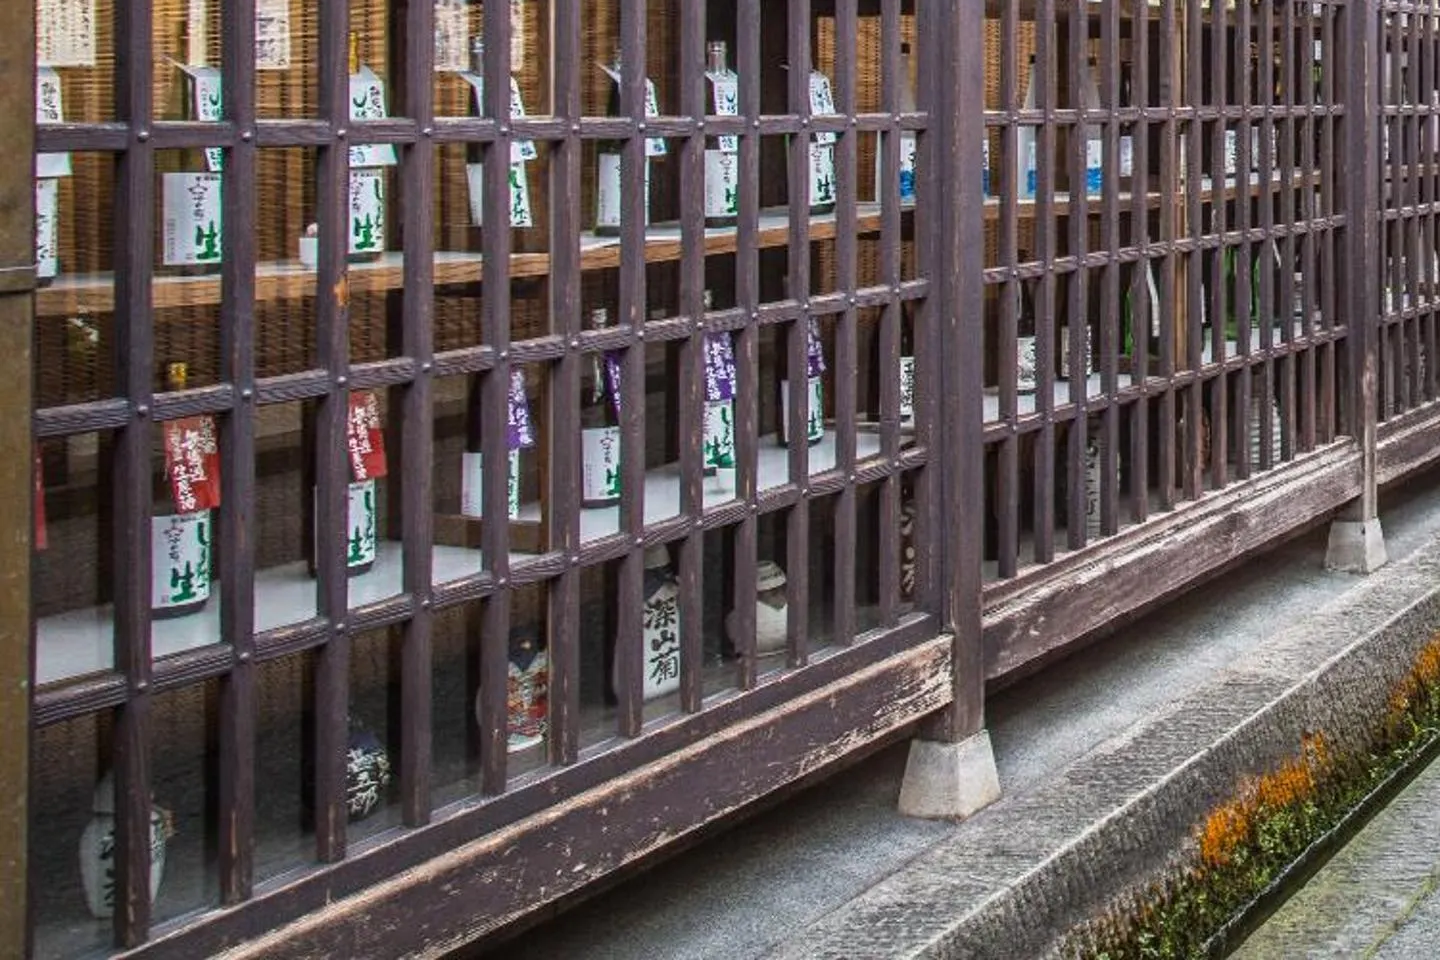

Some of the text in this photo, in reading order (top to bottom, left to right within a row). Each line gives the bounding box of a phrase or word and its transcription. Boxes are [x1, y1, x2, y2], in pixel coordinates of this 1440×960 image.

[171, 561, 198, 603] 生
[644, 596, 680, 686] 深山菊
